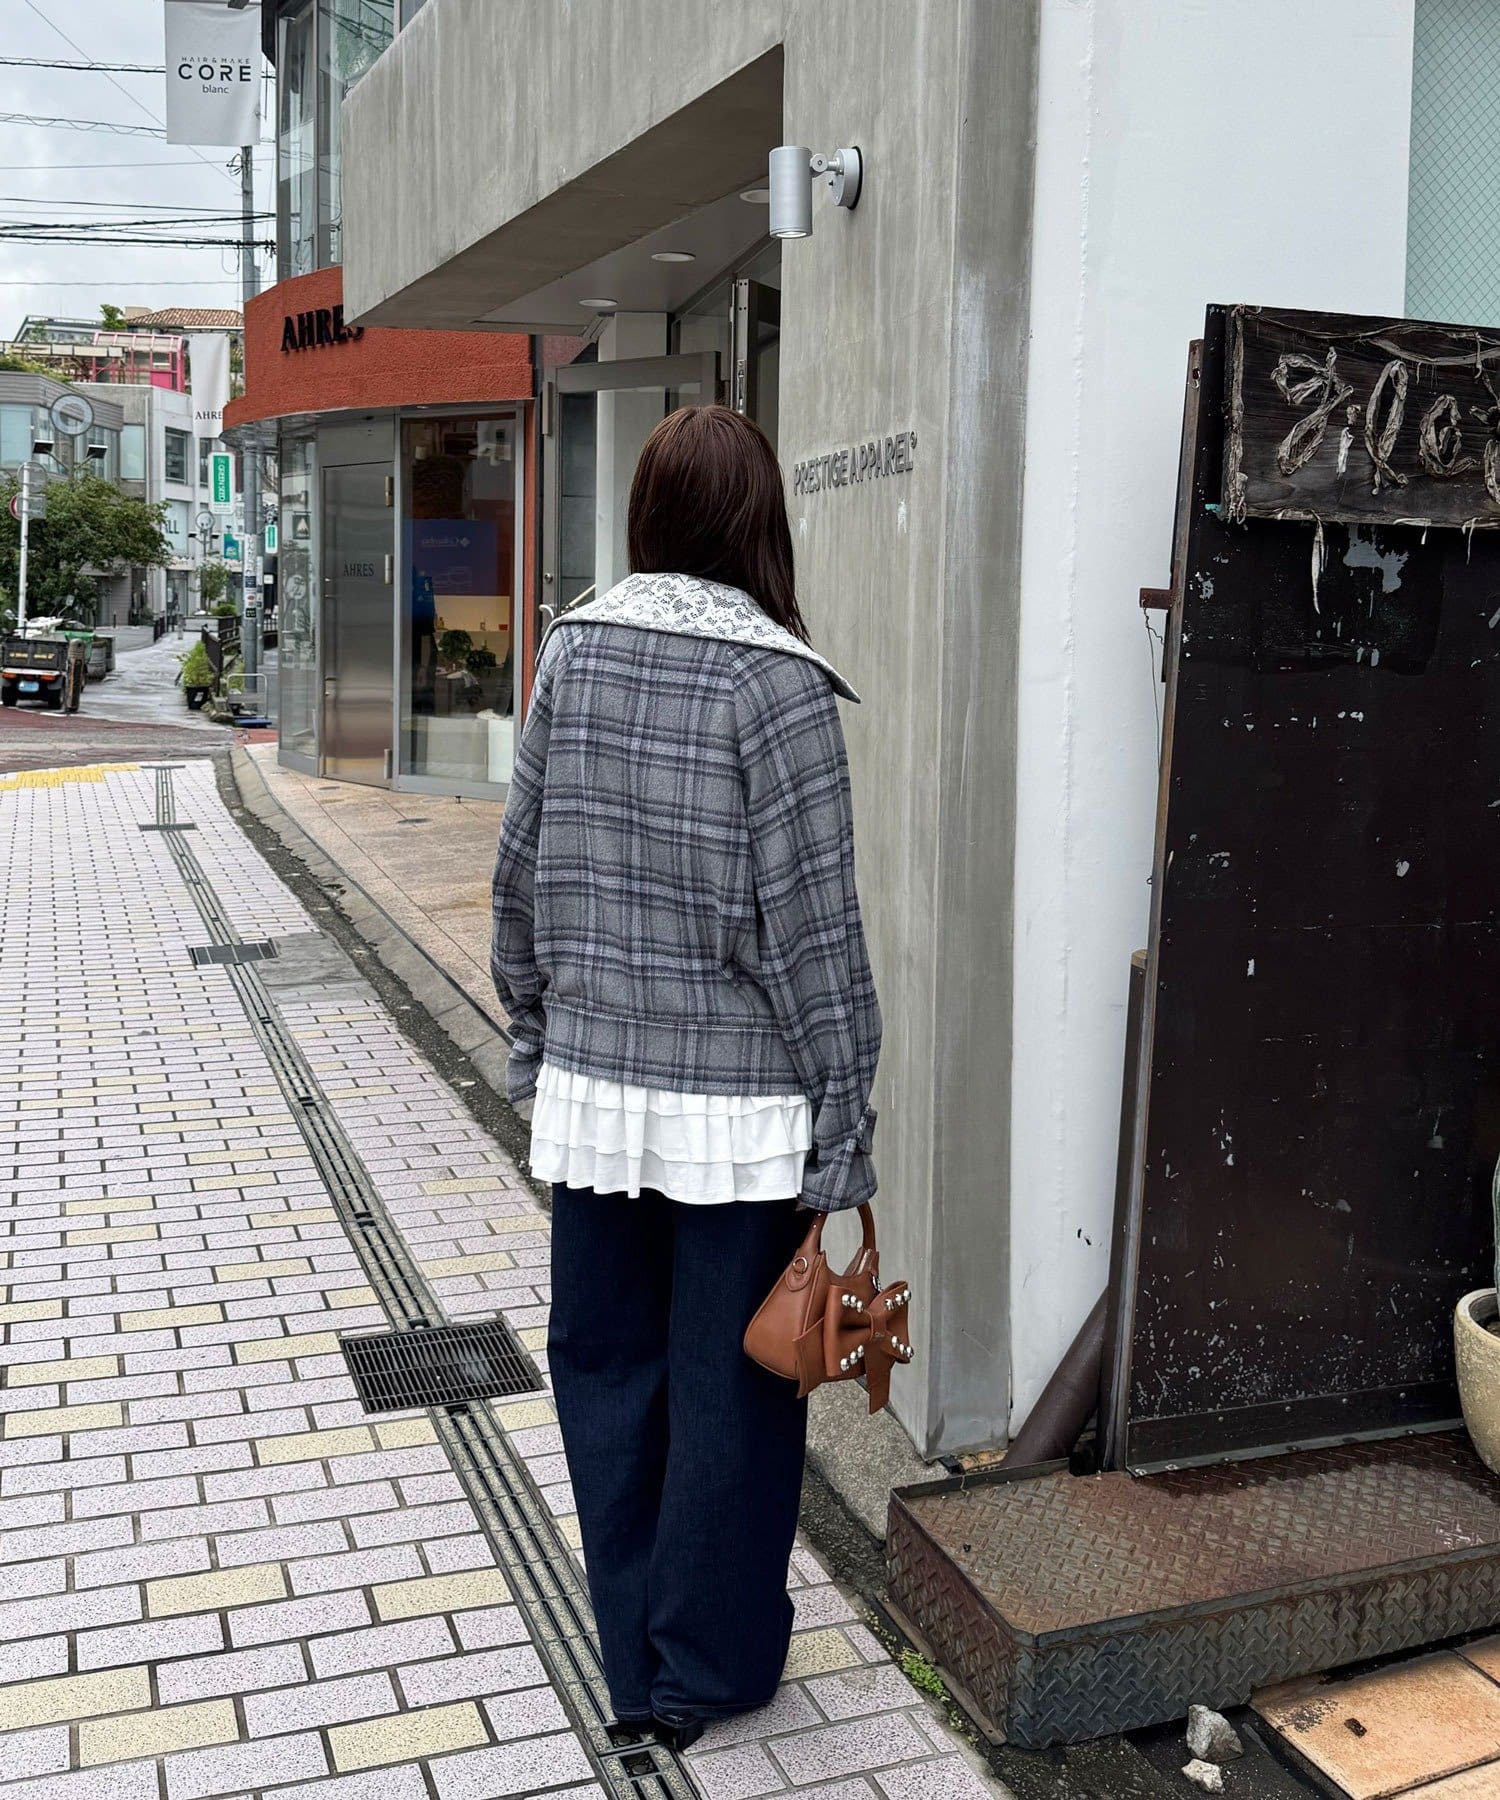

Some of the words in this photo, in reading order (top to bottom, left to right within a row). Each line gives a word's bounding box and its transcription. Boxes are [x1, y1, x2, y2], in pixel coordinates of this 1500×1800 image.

[178, 63, 252, 82] CORE
[202, 84, 229, 94] blanc
[793, 450, 849, 496] PRESTIGE
[343, 561, 375, 577] AHRES
